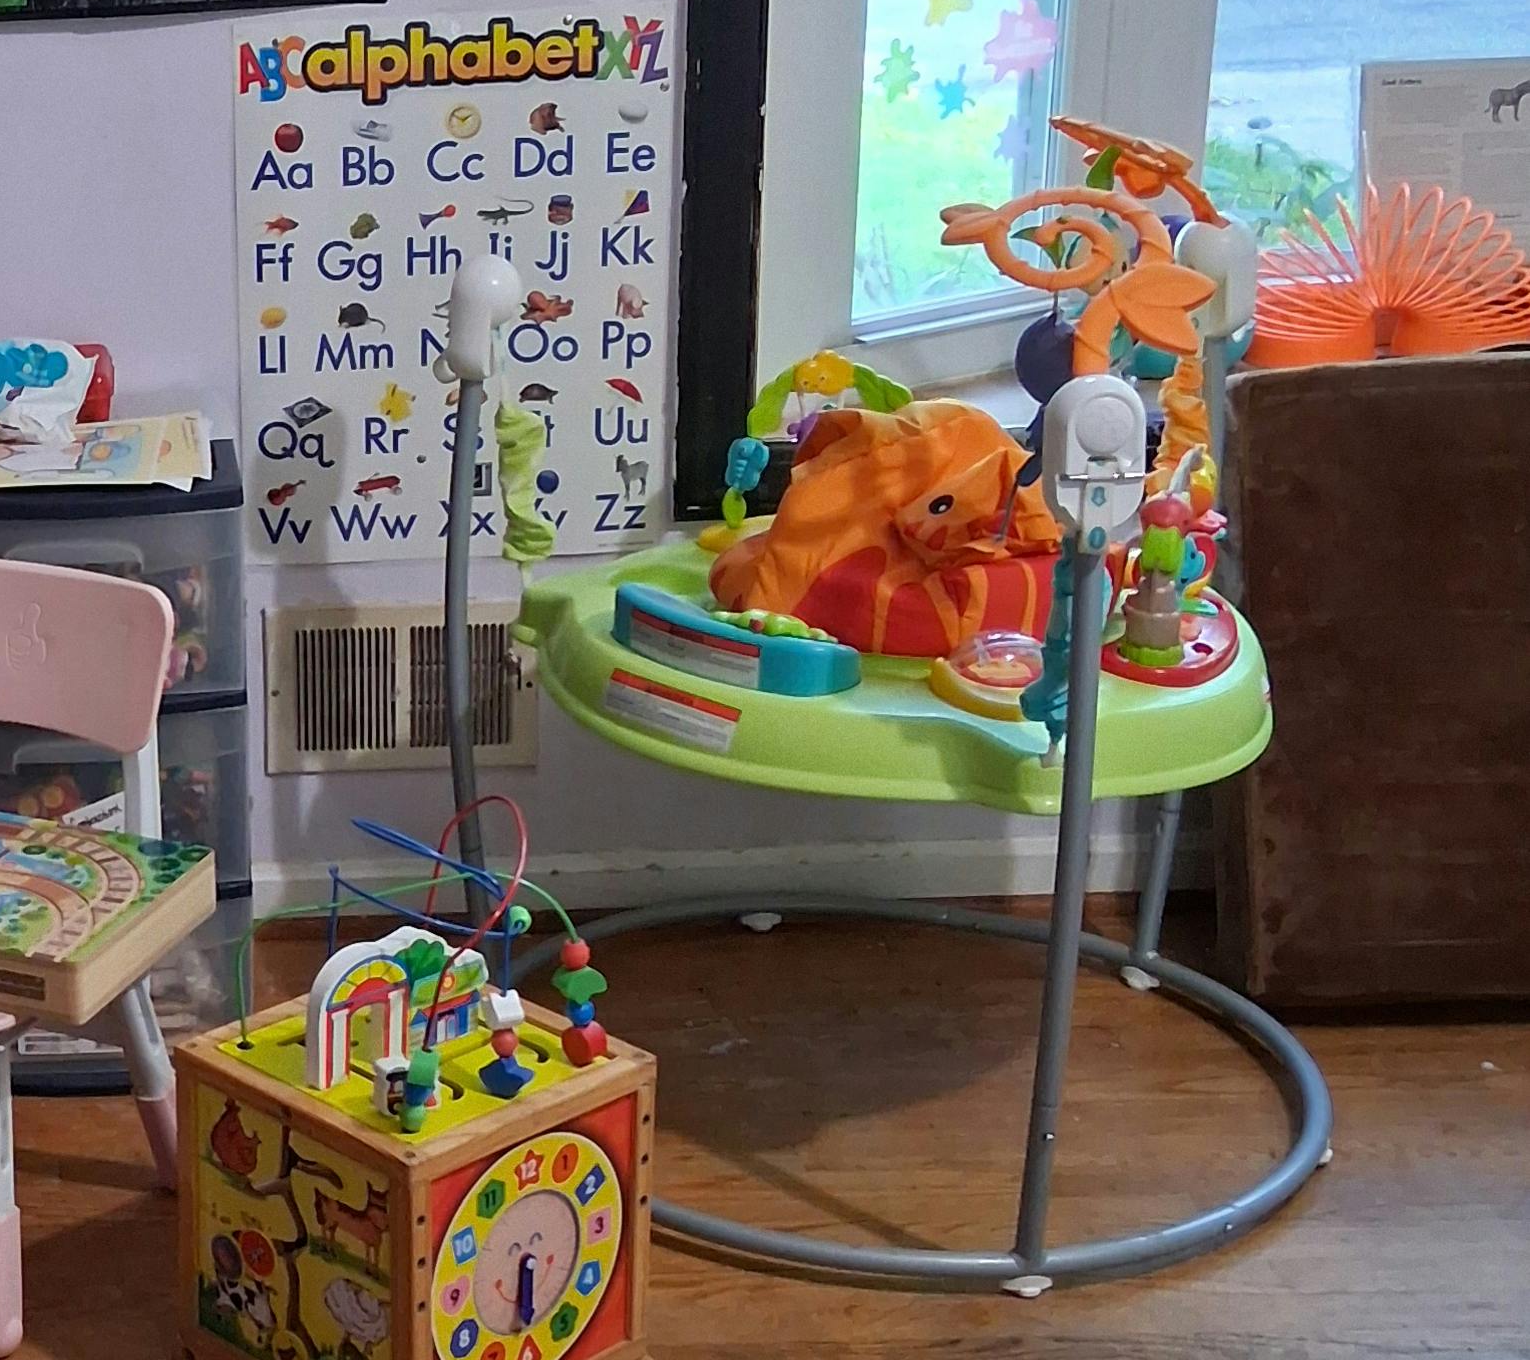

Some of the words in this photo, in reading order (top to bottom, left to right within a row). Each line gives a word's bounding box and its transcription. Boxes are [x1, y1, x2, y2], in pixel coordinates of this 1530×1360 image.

[239, 34, 306, 102] ABC
[304, 19, 602, 103] alphabet
[595, 15, 669, 84] XYZ
[251, 149, 314, 191] Aa
[341, 145, 395, 187] Bb
[426, 141, 485, 182] Cc
[513, 135, 574, 178] Dd
[606, 131, 656, 174] Ee
[255, 242, 295, 283] Ff
[317, 240, 383, 291] Gg
[406, 235, 462, 277] Hh
[535, 230, 569, 282] Jj
[601, 226, 654, 268] Kk
[258, 335, 286, 376] Ll
[315, 333, 394, 373] Mm
[421, 328, 446, 368] N
[508, 323, 579, 364] Oo
[601, 321, 651, 369] Pp
[258, 421, 335, 469] Qq
[364, 417, 410, 455] Rr
[594, 408, 649, 446] Uu
[258, 507, 312, 545] Vv
[330, 503, 418, 542] Ww
[593, 493, 647, 533] Zz
[519, 1158, 537, 1178] 12
[561, 1155, 569, 1171] 1
[584, 1175, 597, 1195] 2
[483, 1191, 496, 1210] 11
[595, 1216, 604, 1234] 3
[454, 1236, 471, 1256] 10
[583, 1267, 594, 1285] 4
[449, 1289, 461, 1306] 9
[558, 1313, 568, 1329] 5
[458, 1328, 470, 1348] 8
